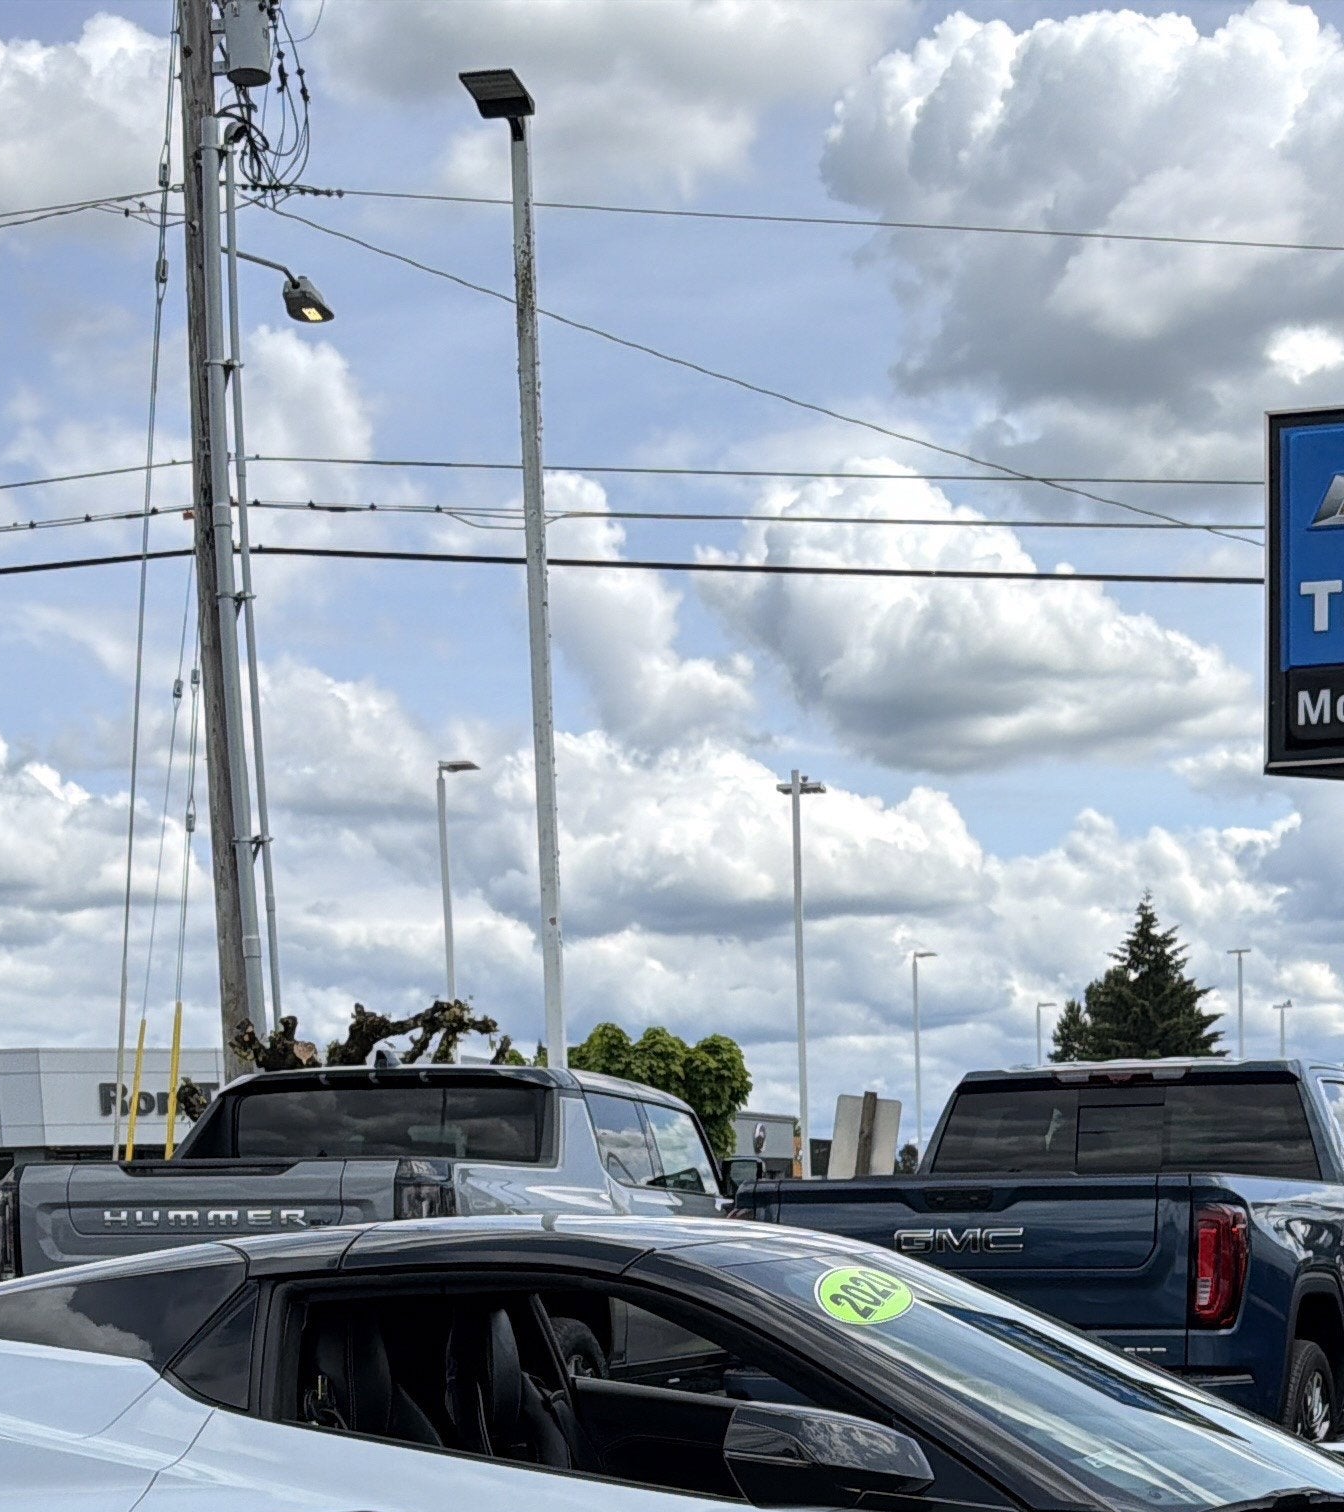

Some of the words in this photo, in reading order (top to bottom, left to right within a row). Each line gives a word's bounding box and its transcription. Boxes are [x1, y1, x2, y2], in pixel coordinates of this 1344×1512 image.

[103, 1209, 307, 1227] HUMMER
[893, 1226, 1024, 1254] GMC
[828, 1269, 902, 1321] 2020
